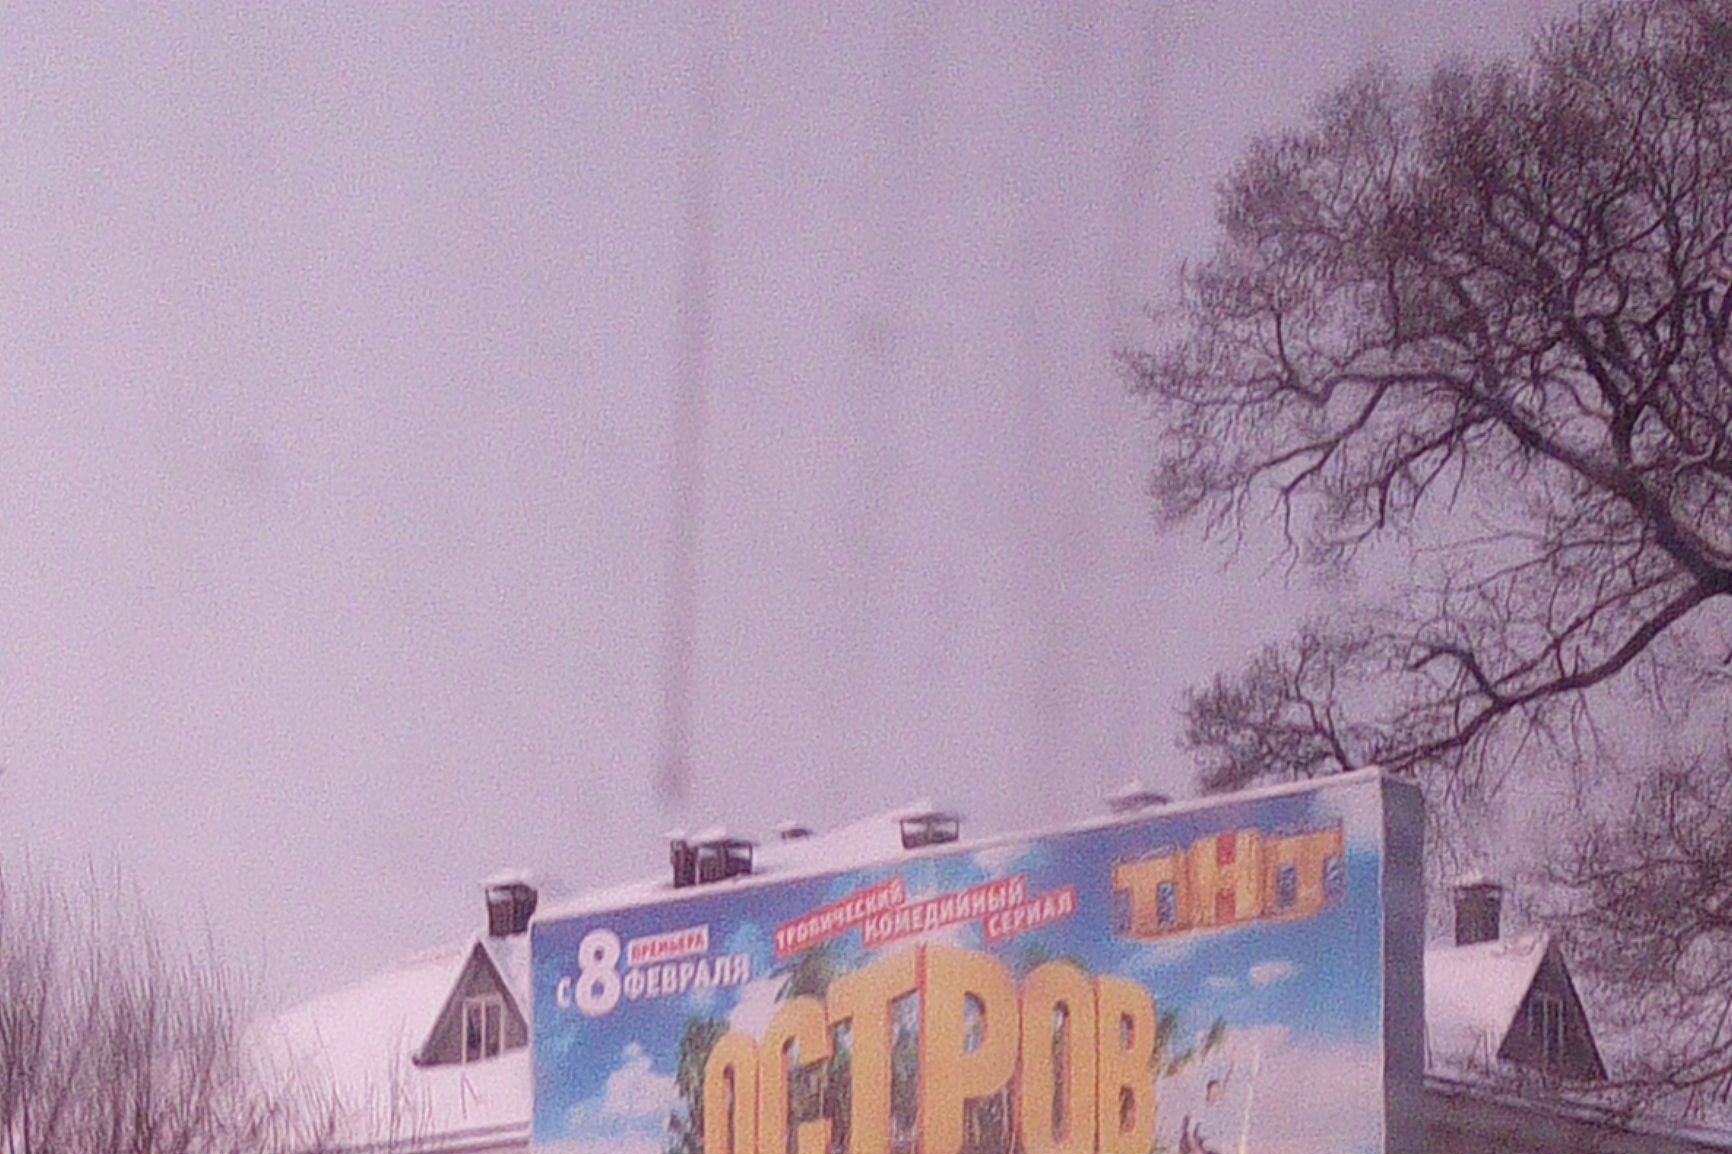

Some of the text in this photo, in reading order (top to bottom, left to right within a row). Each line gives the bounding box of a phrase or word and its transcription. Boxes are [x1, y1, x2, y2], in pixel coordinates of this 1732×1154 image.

[863, 877, 1026, 941] КОМЕДИЙНЫЙ
[988, 890, 1074, 938] СЕРИАЛ
[574, 927, 622, 1018] 8
[623, 953, 751, 1001] ФЕВРАЛЯ
[631, 933, 706, 961] ПРЕМЬЕРА
